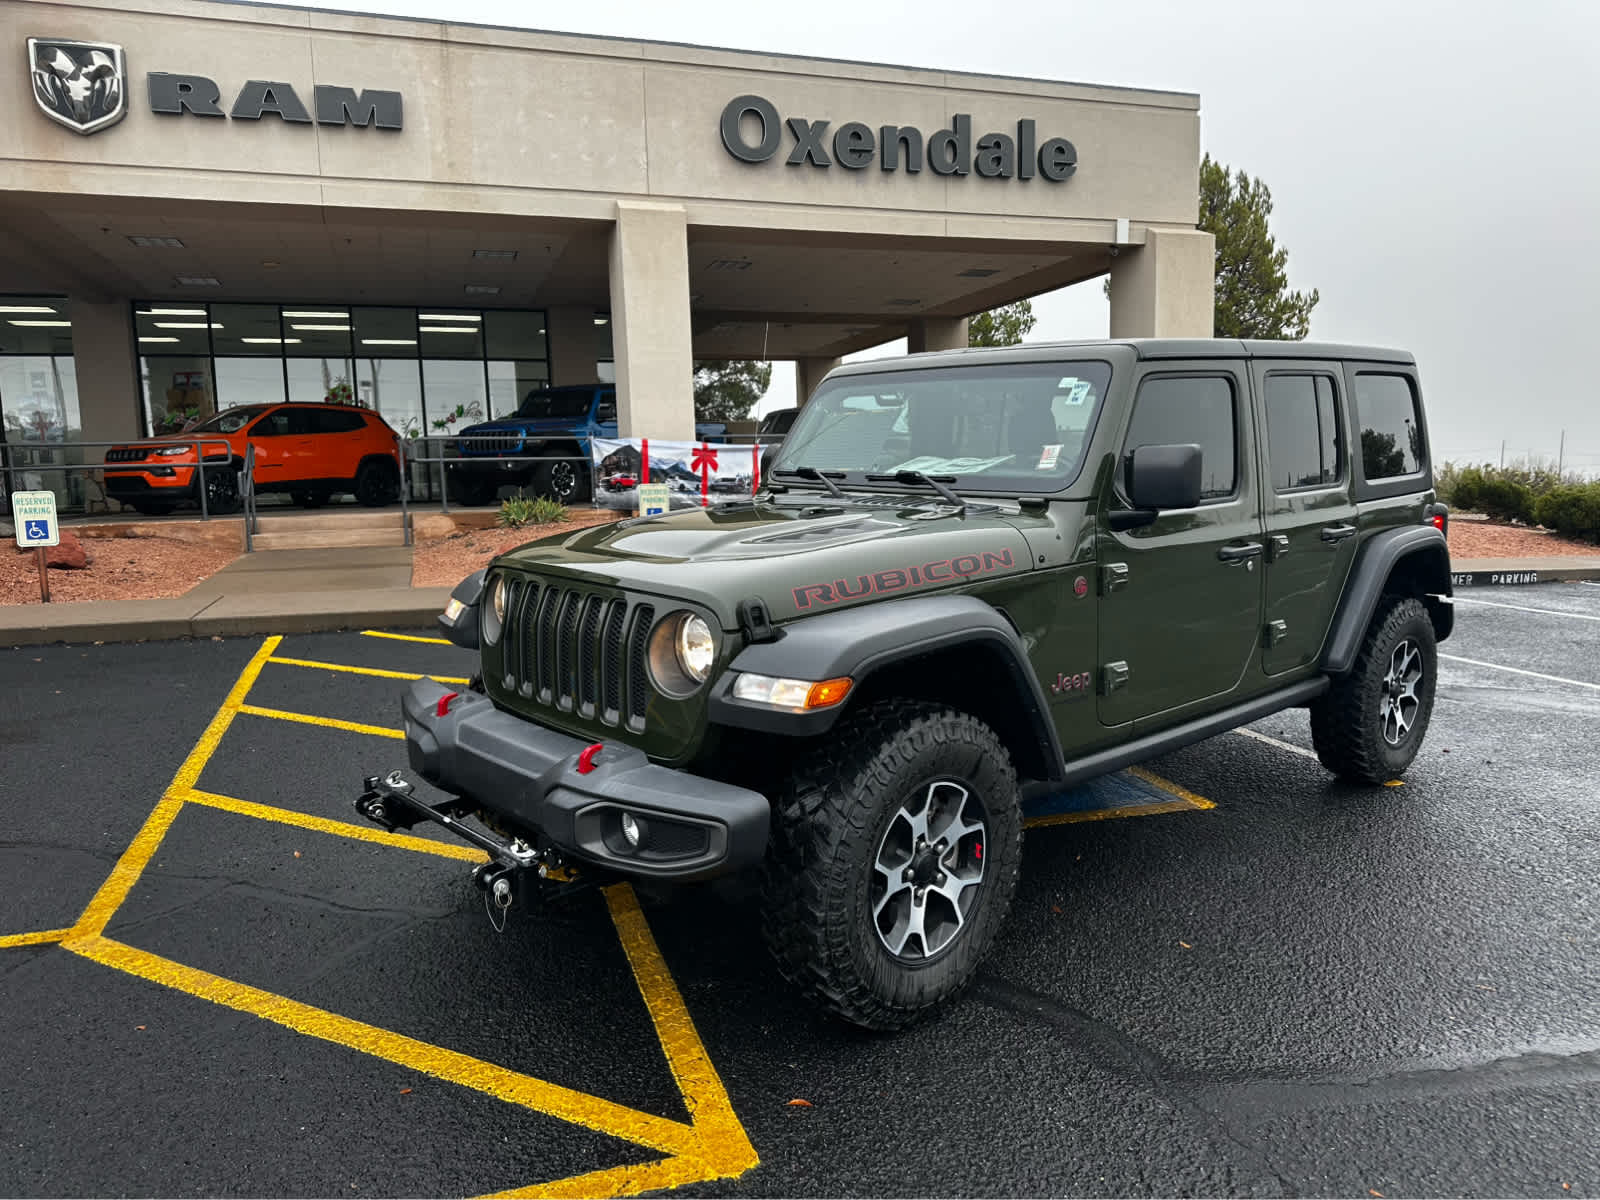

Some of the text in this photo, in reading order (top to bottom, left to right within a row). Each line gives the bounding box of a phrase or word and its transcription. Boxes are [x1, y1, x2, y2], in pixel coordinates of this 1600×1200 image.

[147, 72, 402, 129] RAM
[720, 94, 1078, 181] Oxendale
[15, 497, 53, 505] RESERVED
[19, 507, 51, 515] PARKING
[792, 547, 1015, 609] RUBICON
[1491, 573, 1537, 585] PARKING
[1050, 672, 1091, 696] Jeep
